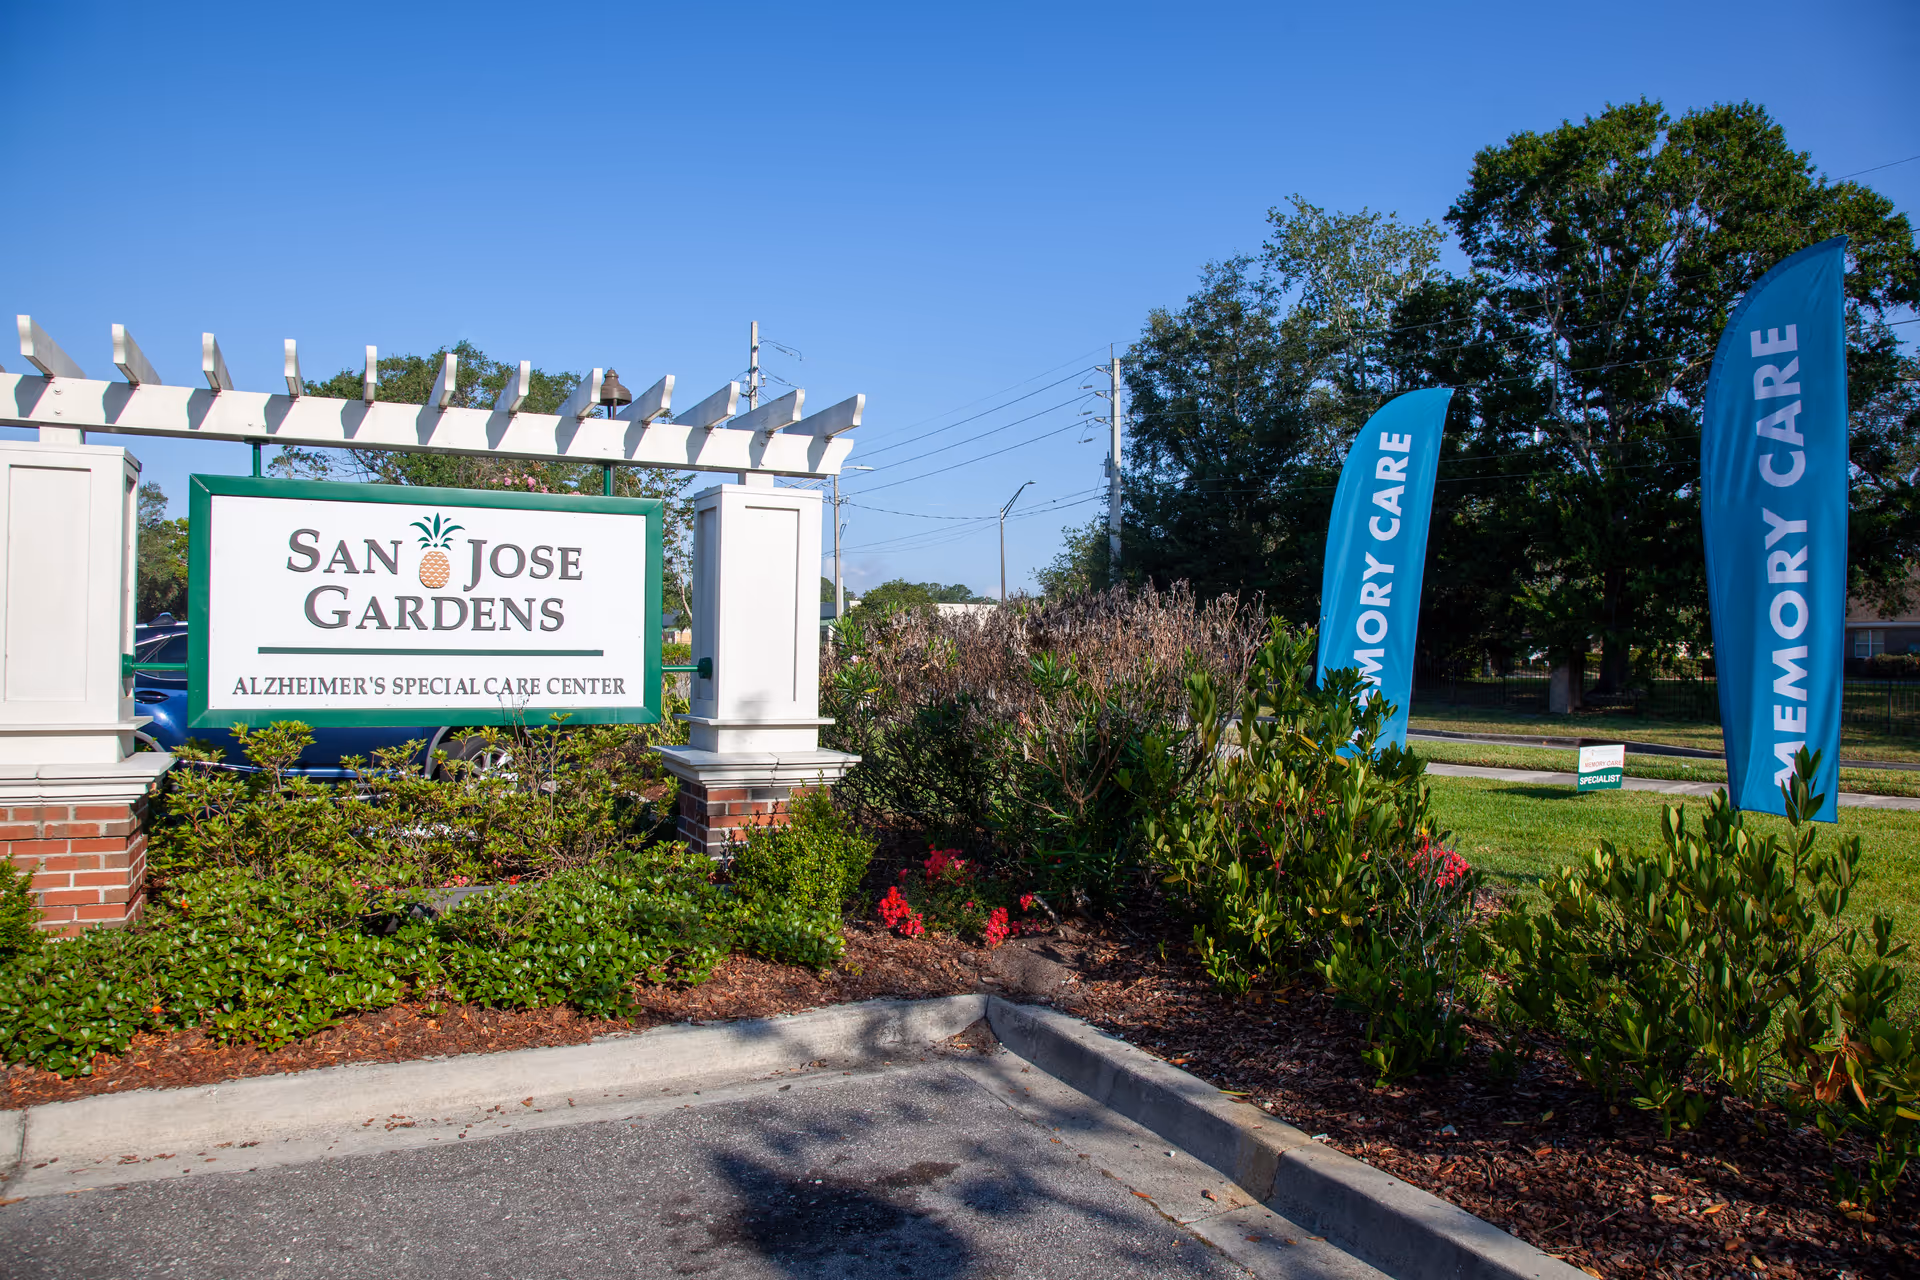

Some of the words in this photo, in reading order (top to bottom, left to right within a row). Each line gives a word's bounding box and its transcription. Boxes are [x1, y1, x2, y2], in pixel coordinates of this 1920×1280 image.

[1750, 323, 1807, 488] CARE
[1368, 432, 1412, 541] CARE
[286, 528, 403, 576] SAN
[463, 538, 583, 592] JOSE
[304, 585, 565, 632] GARDENS
[1762, 507, 1809, 792] MEMORY
[232, 676, 386, 695] ALZHEIMER'S
[392, 677, 480, 695] SPECIAL
[483, 677, 541, 695] CARE
[546, 677, 626, 695] CENTER
[1579, 774, 1621, 785] SPECIALIST
[1584, 760, 1605, 768] MEMORY
